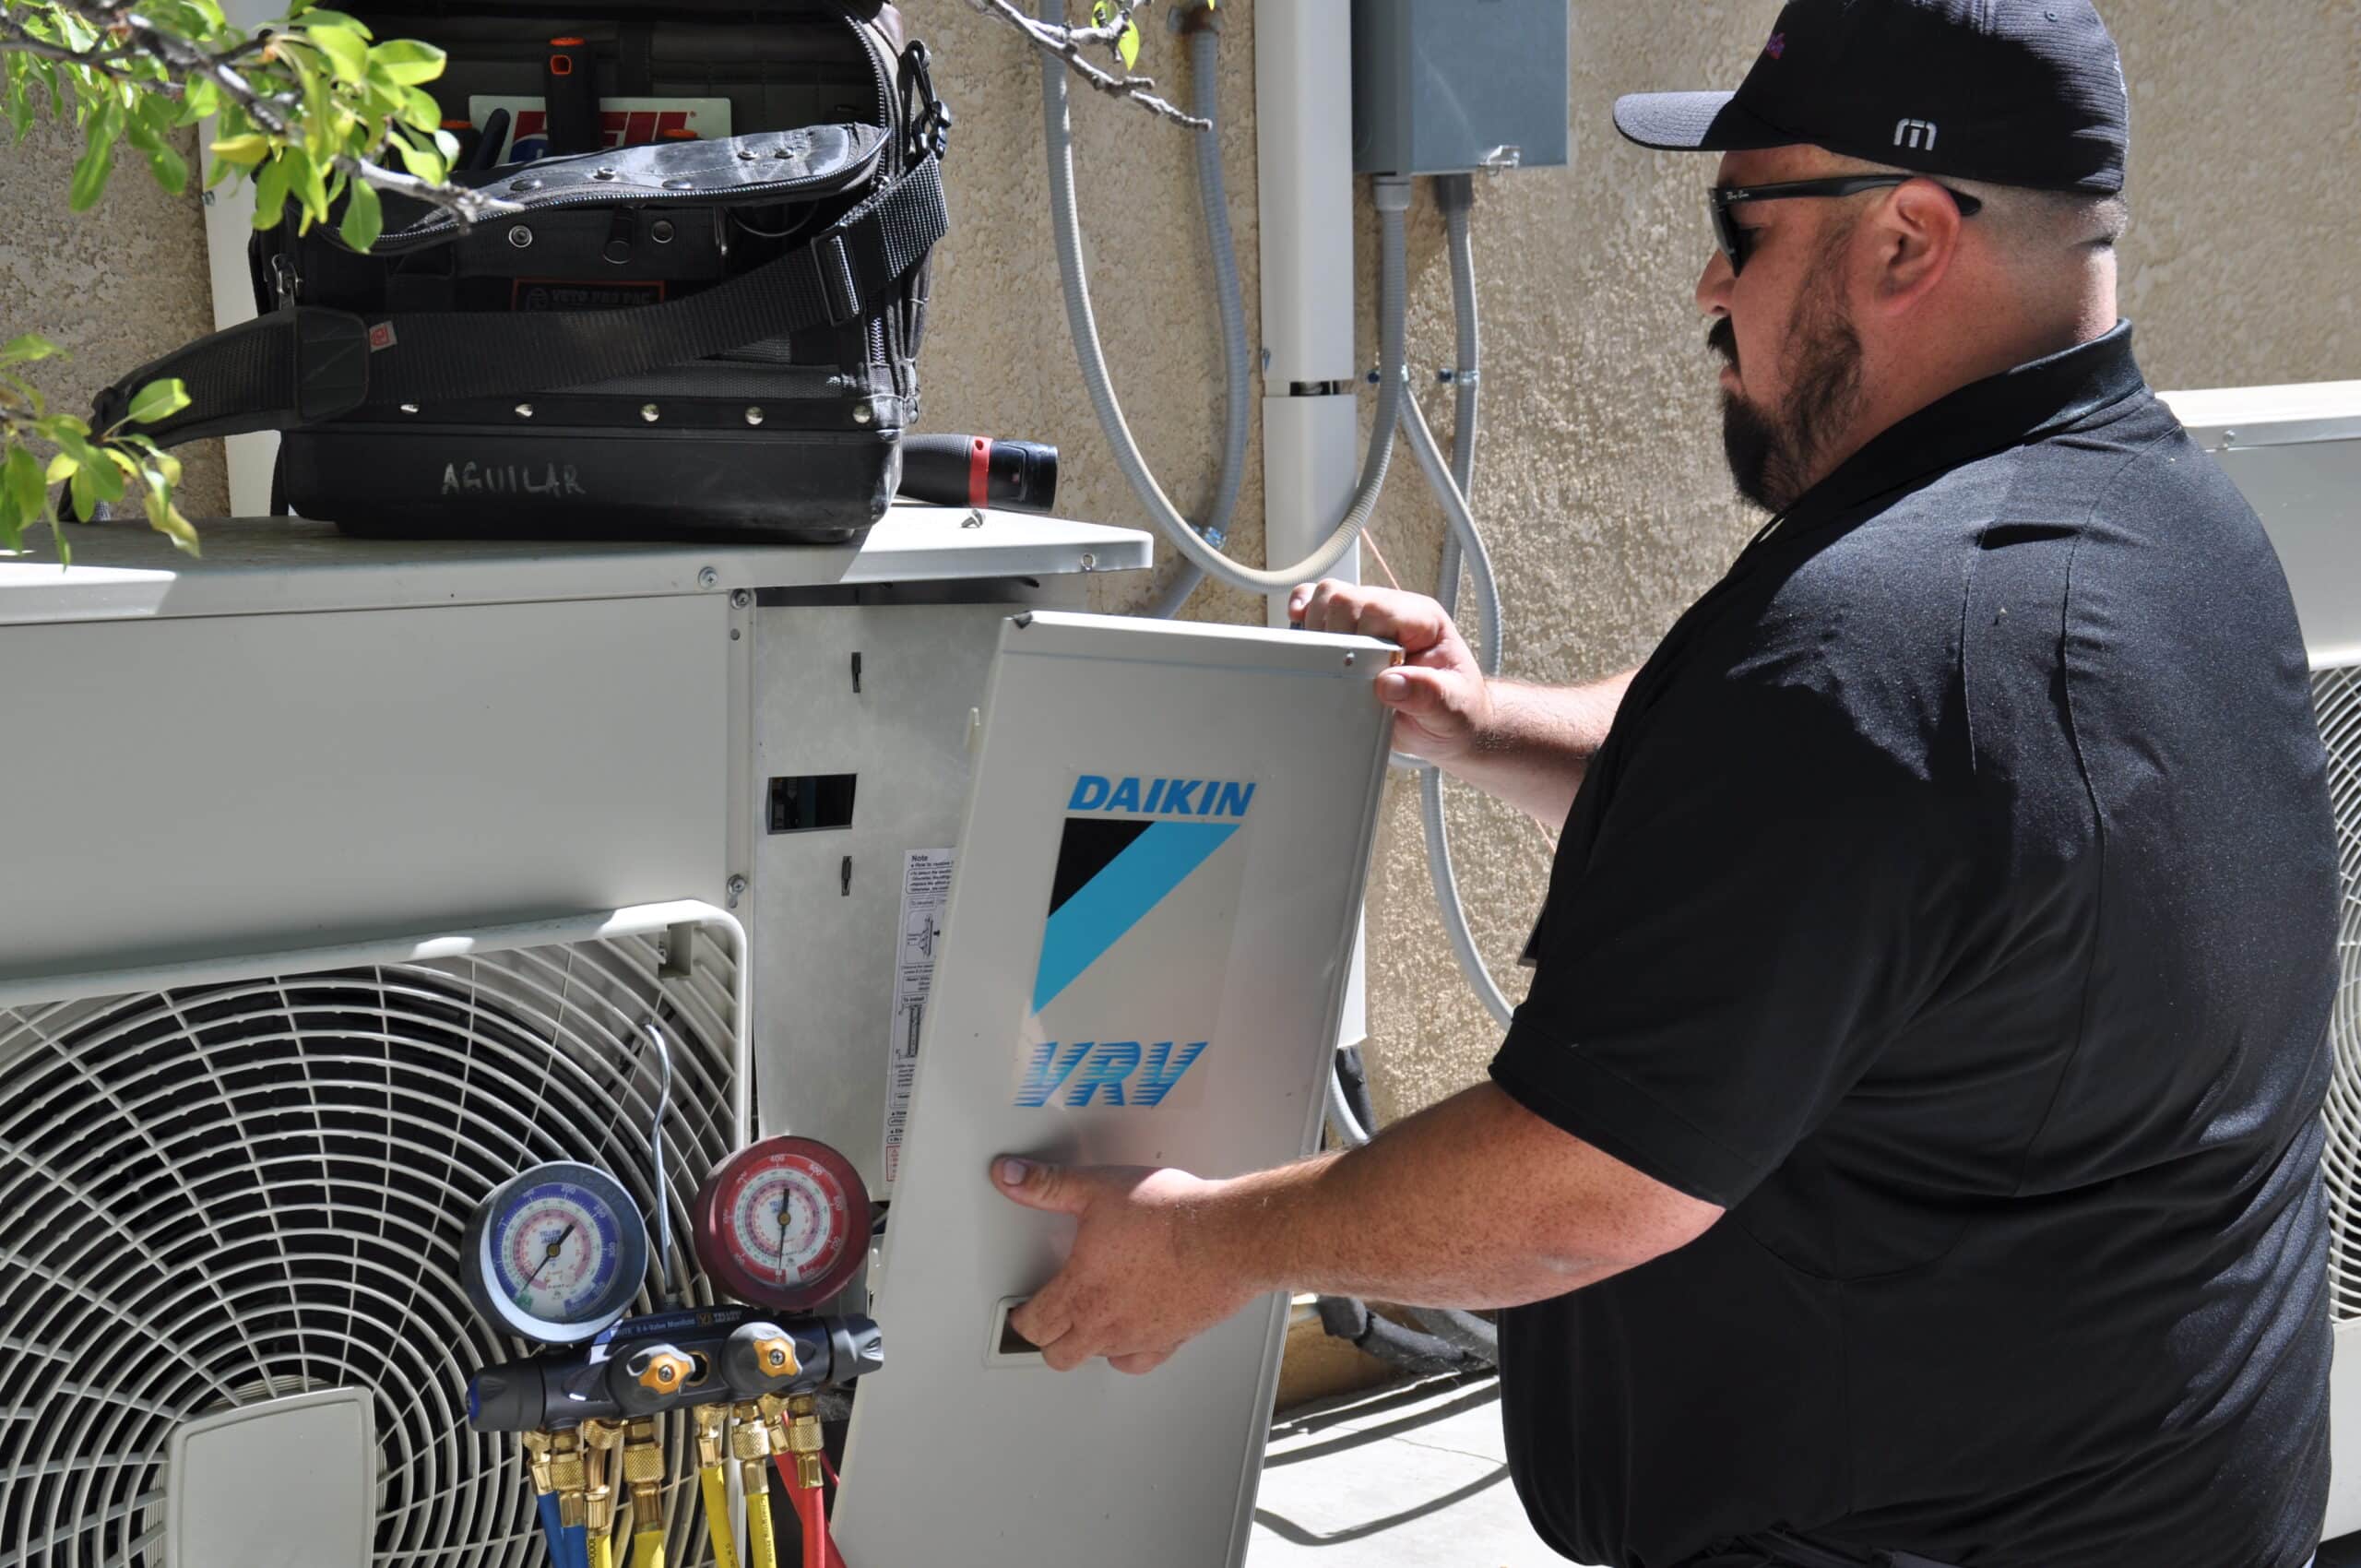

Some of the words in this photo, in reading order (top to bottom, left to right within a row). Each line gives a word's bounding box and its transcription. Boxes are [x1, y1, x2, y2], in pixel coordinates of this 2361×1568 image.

[441, 461, 587, 498] AGUILAR
[1066, 775, 1257, 817] DAIKIN
[911, 854, 929, 862] Note
[1013, 1041, 1208, 1107] VRV
